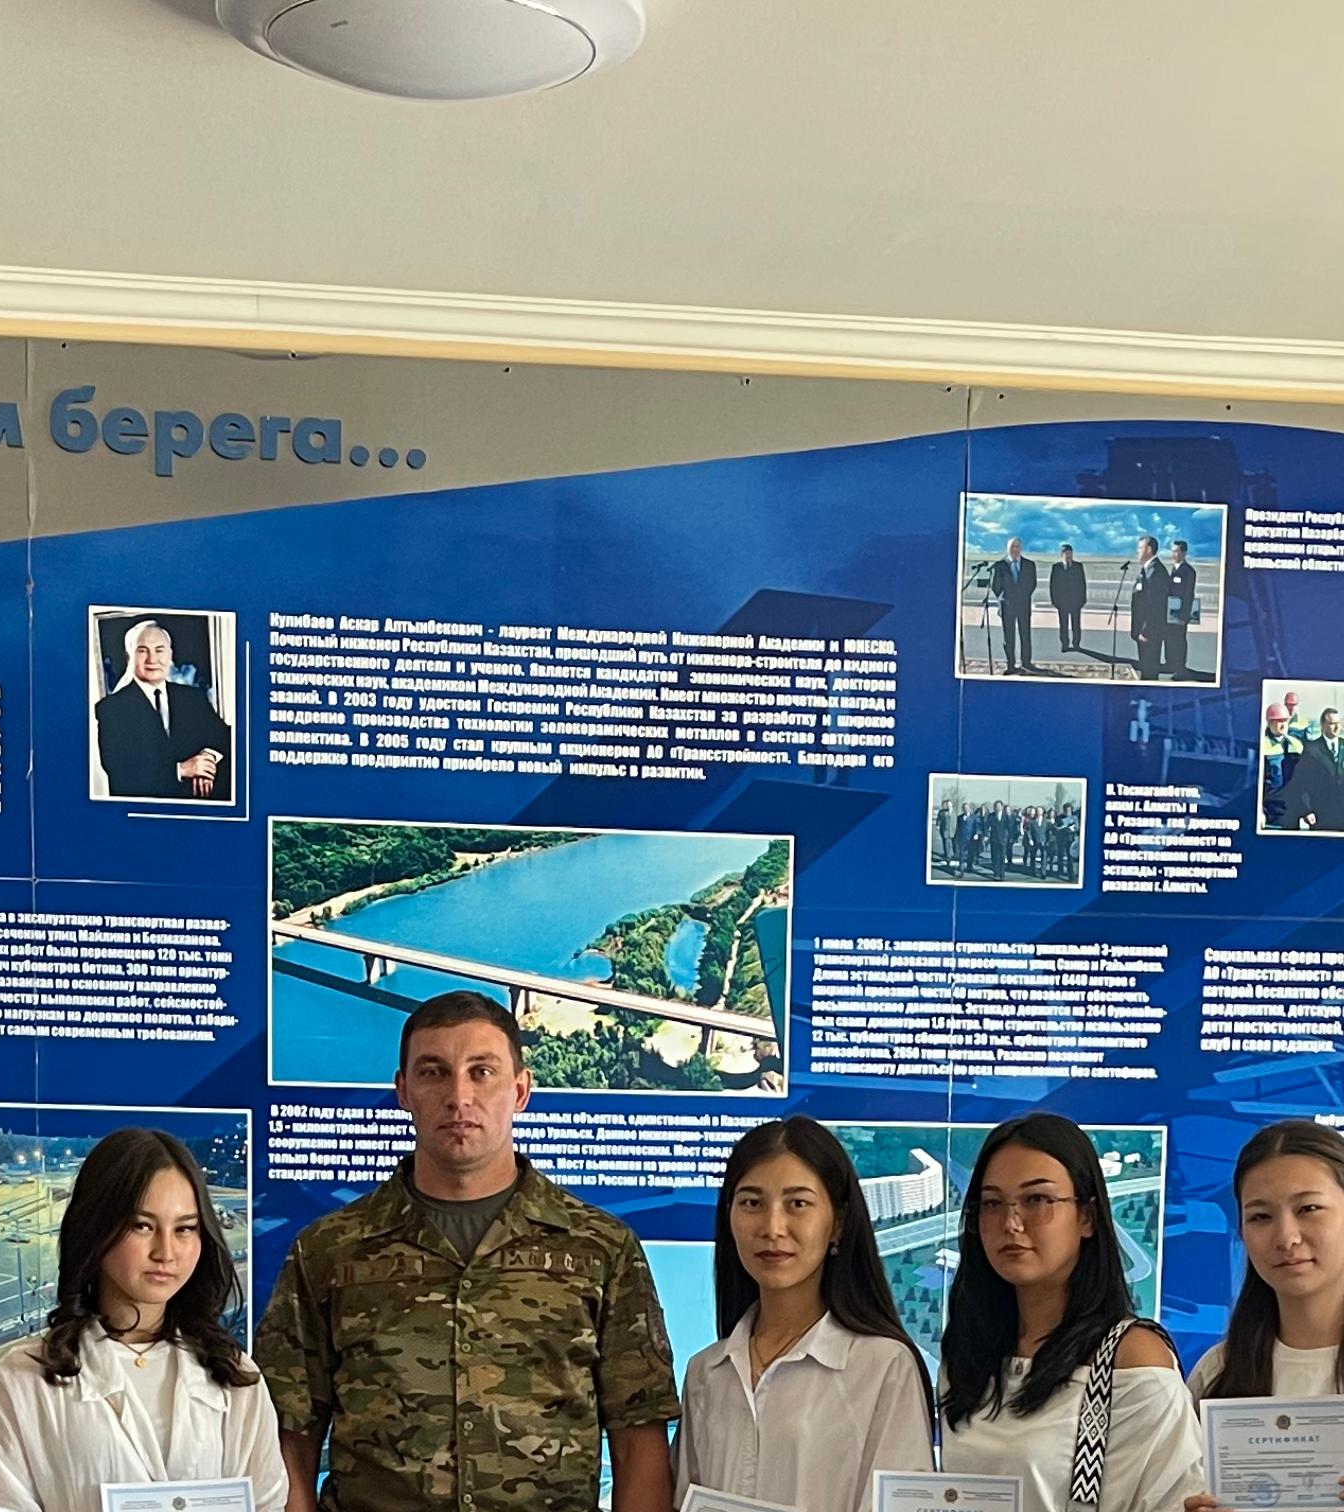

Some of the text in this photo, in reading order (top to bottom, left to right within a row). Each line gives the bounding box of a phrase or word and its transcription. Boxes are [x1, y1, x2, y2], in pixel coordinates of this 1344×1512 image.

[49, 384, 429, 478] берега...
[270, 1104, 279, 1117] В
[280, 1105, 308, 1118] 2002
[309, 1107, 336, 1120] году
[1248, 1435, 1321, 1445] СЕРТИФИКАТ
